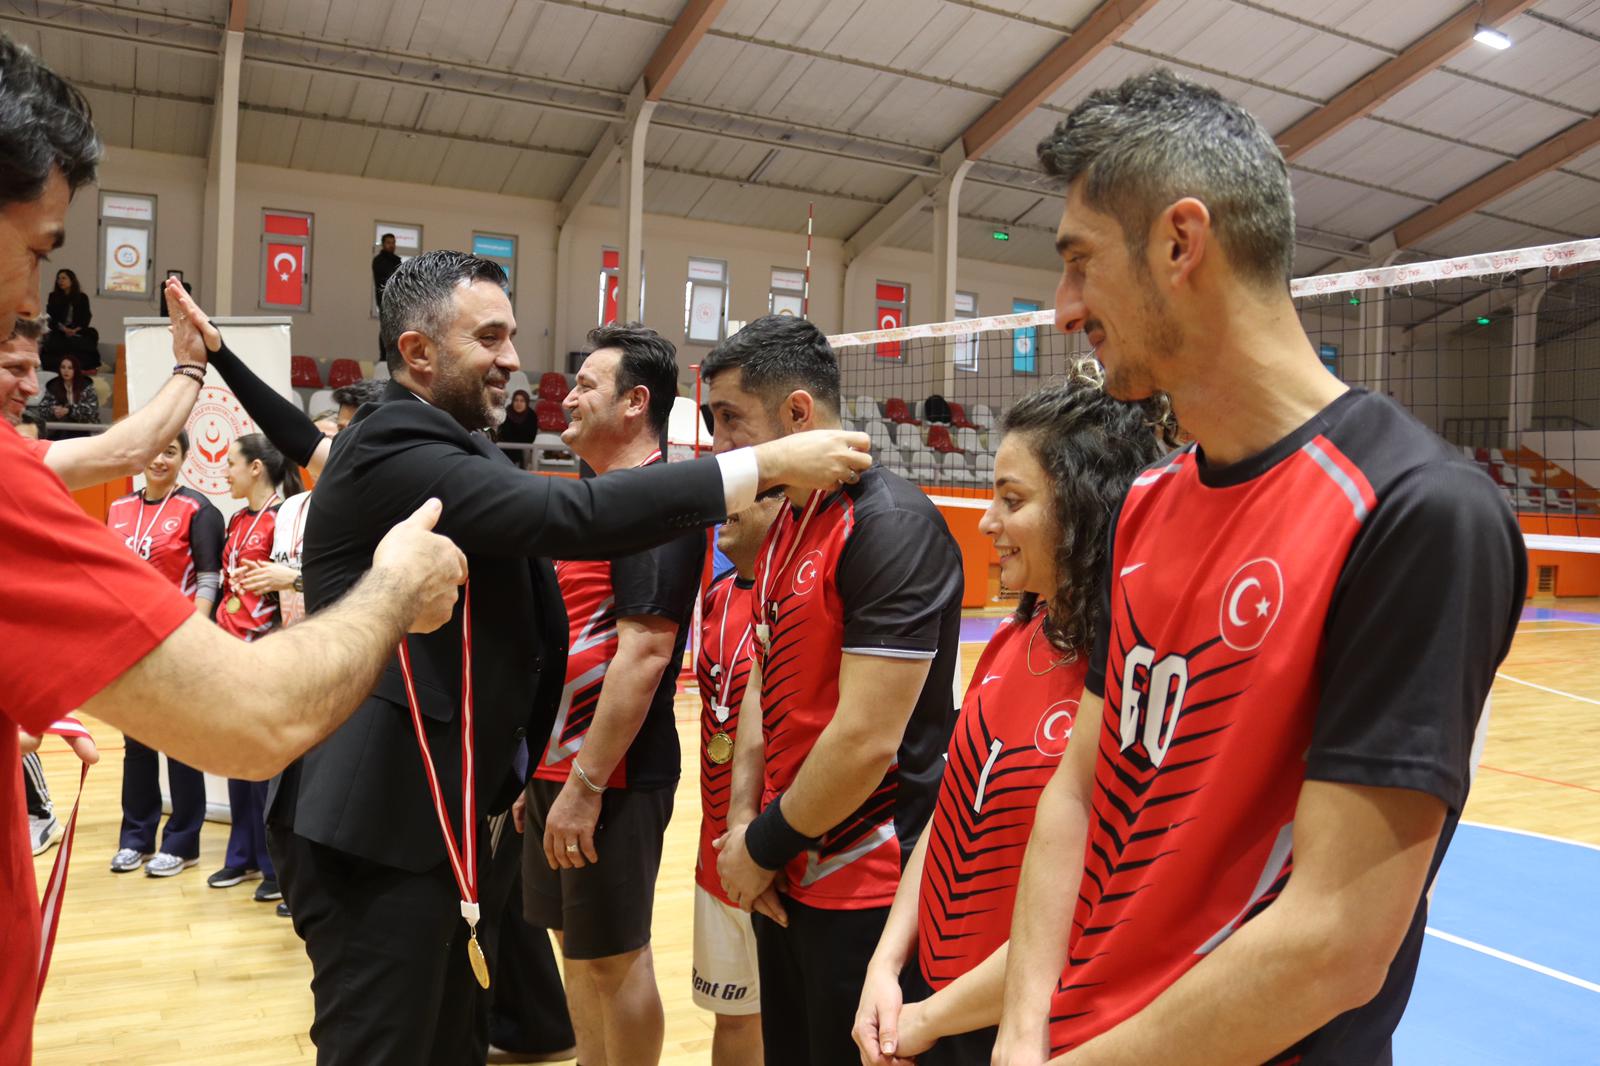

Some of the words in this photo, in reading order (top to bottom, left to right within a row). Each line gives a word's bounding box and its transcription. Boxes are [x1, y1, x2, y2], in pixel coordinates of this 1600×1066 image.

[1555, 249, 1577, 259] TVF
[1503, 256, 1520, 264] TVF
[721, 983, 748, 1001] Go
